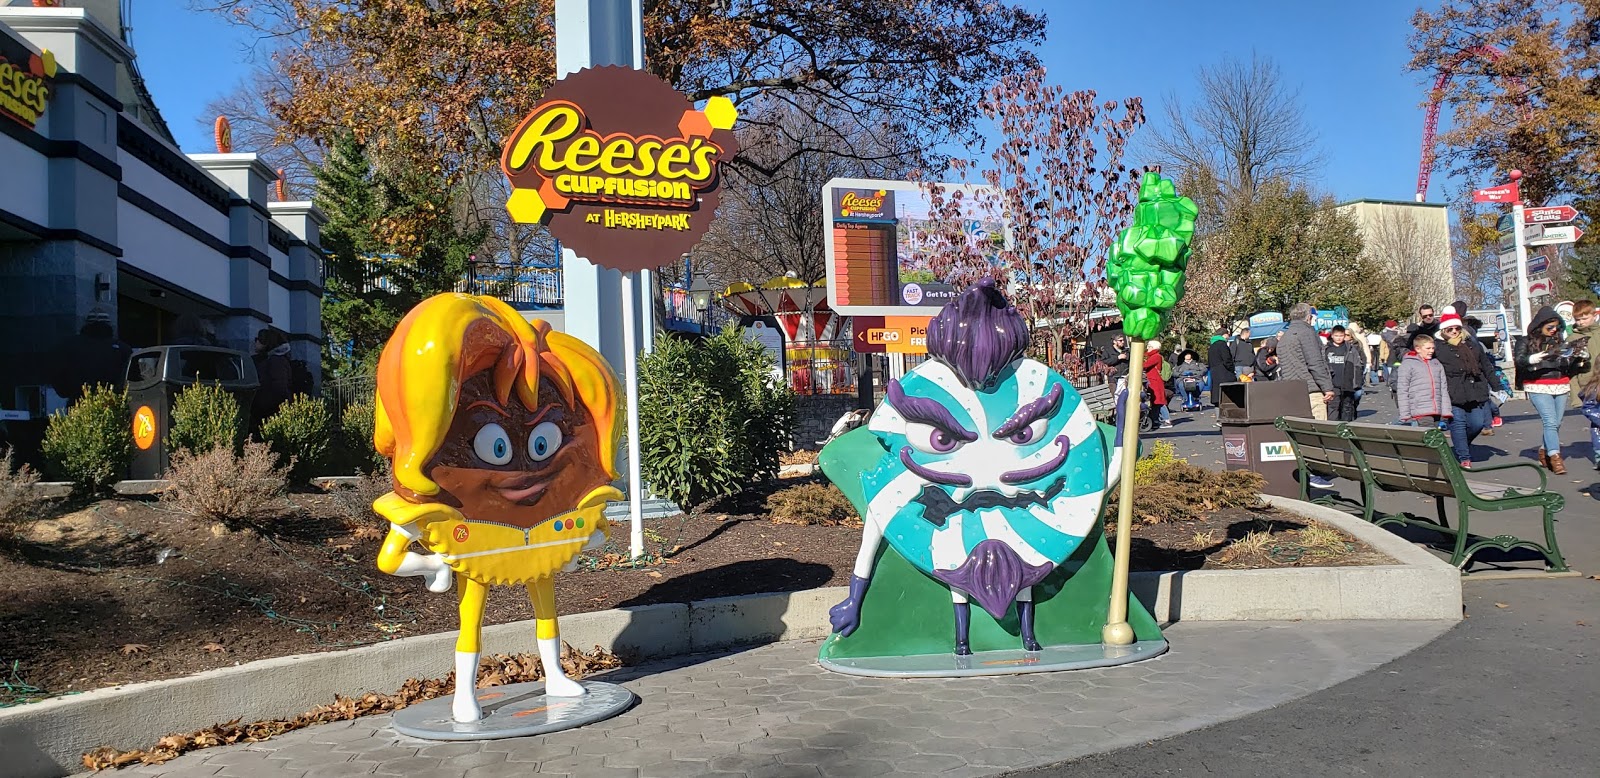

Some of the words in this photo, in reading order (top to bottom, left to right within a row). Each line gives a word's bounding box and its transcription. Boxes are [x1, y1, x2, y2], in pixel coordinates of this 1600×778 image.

[0, 63, 49, 113] ese's
[510, 107, 717, 181] Reese's
[841, 192, 882, 208] Reese's
[585, 213, 601, 223] AT
[603, 209, 690, 230] HERSHEYPARK
[1531, 209, 1562, 217] Santa
[871, 331, 899, 342] HPGO
[910, 337, 927, 346] FRE
[1265, 444, 1294, 455] WM
